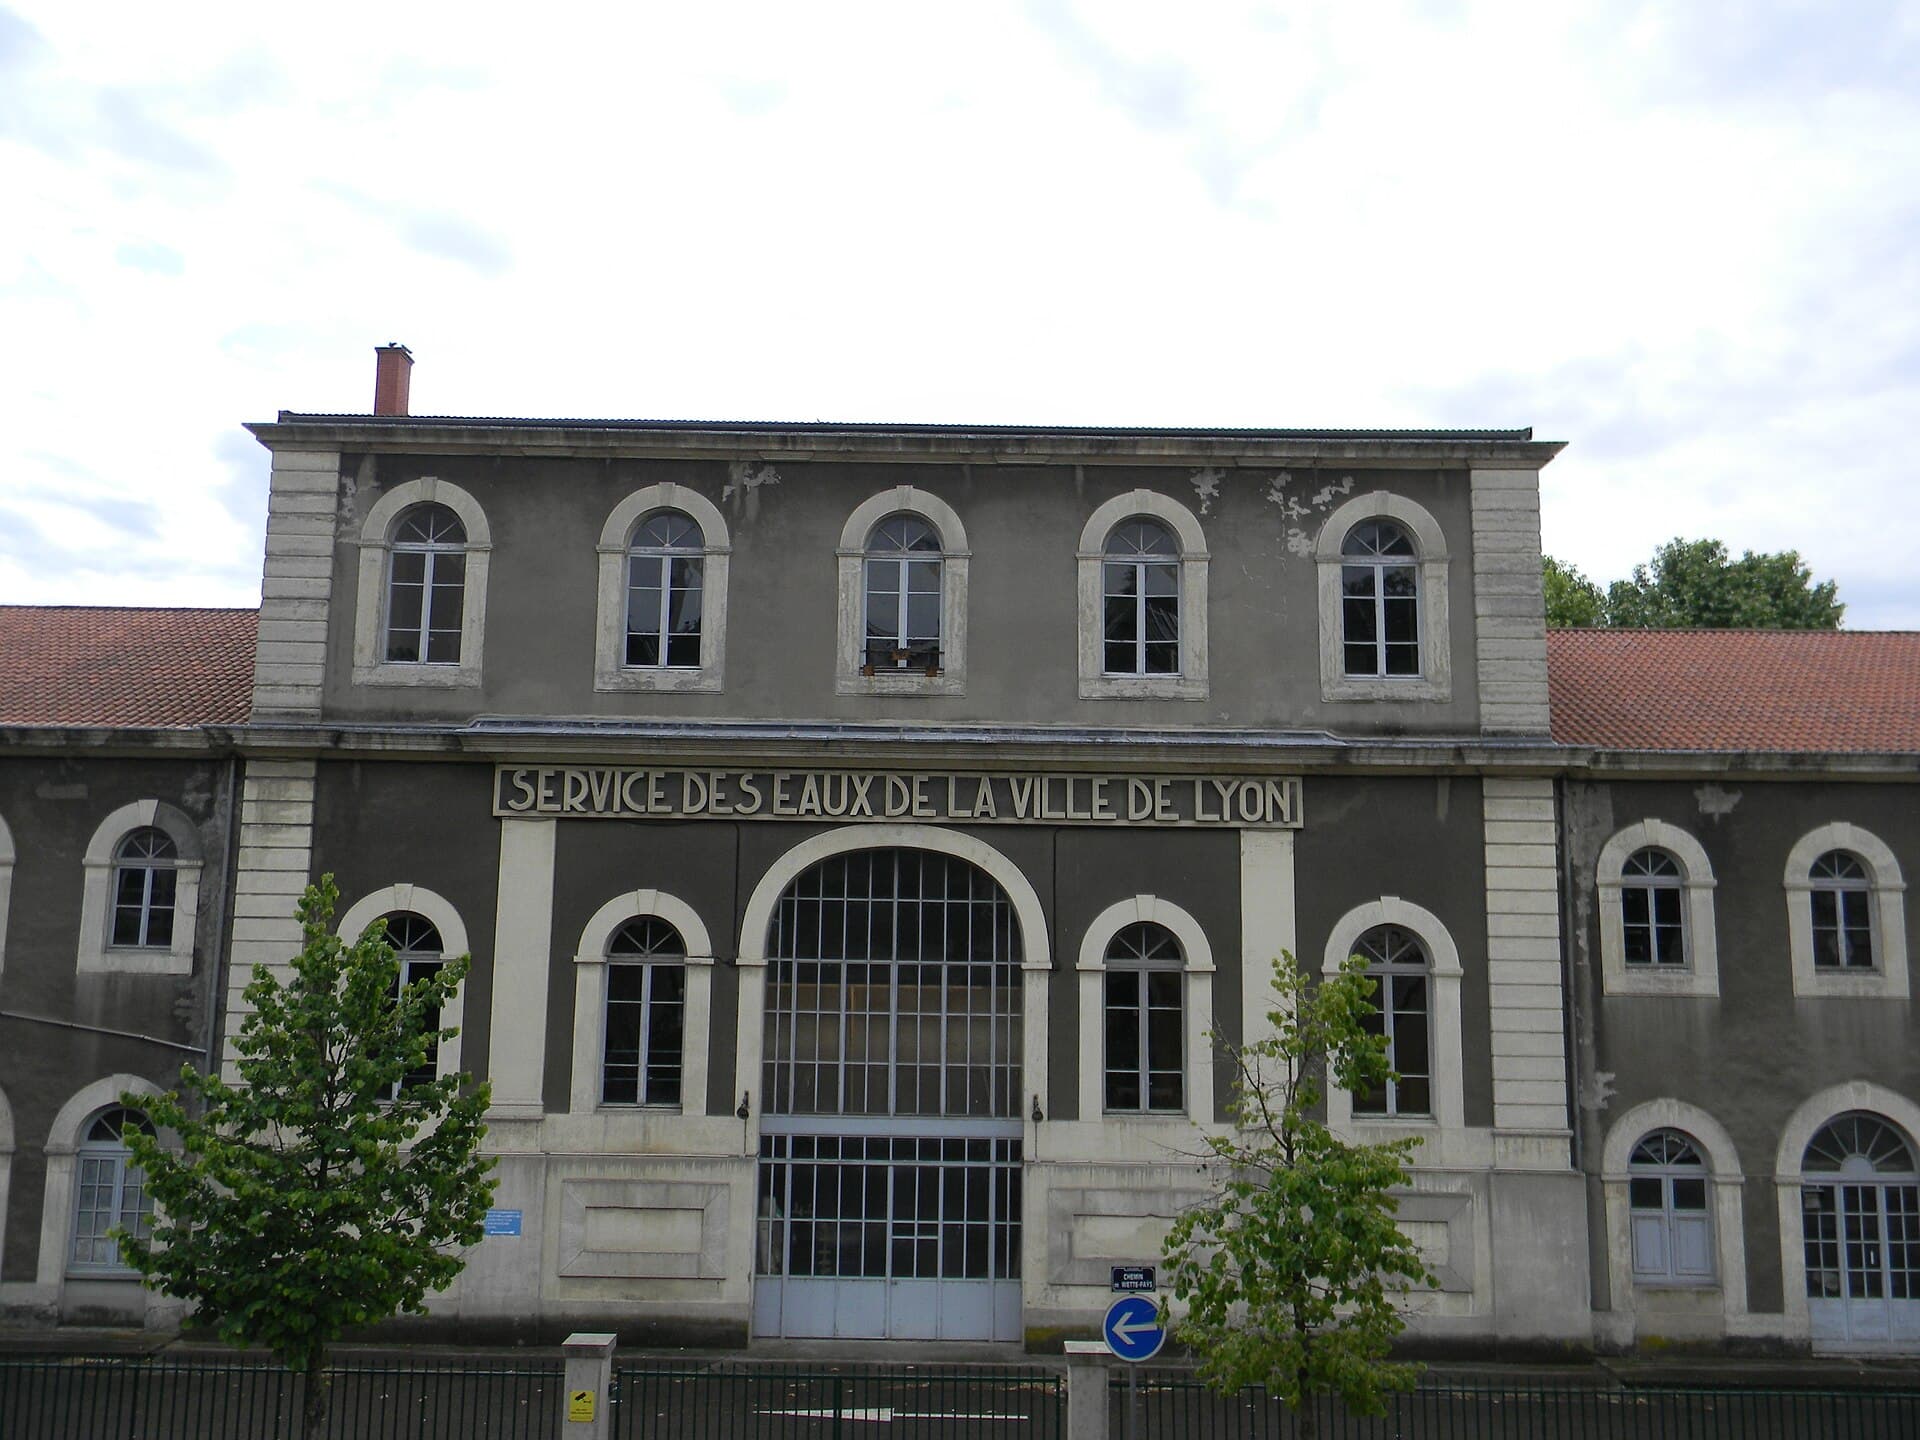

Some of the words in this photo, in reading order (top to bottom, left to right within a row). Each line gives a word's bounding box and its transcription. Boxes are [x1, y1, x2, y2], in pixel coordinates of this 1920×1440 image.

[507, 769, 673, 813] SERVICE
[682, 772, 763, 815] DES
[772, 773, 873, 817] EAUX
[885, 775, 936, 817] DE
[947, 775, 998, 818] LA
[1009, 777, 1117, 819] VILLE
[1128, 778, 1180, 821] DE
[1195, 779, 1291, 823] LYON
